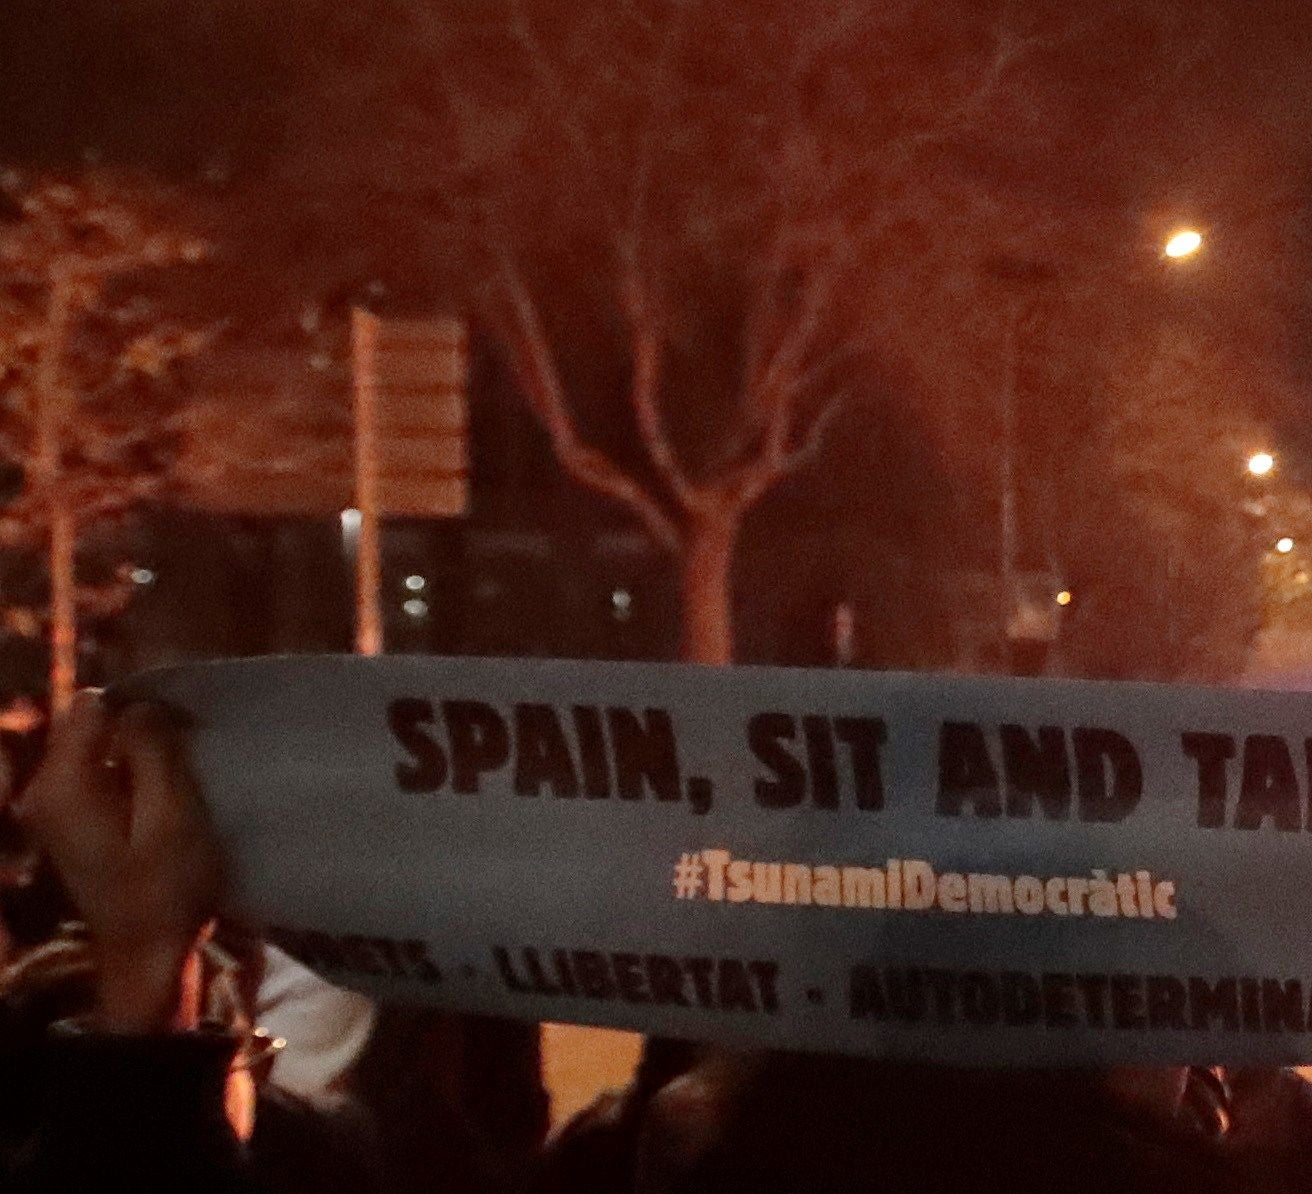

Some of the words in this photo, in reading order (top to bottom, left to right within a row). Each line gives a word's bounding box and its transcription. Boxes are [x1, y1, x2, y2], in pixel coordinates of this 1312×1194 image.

[388, 698, 712, 815] SPAIN,
[747, 713, 889, 813] SIT
[936, 721, 1143, 823] AND
[672, 848, 1178, 920] #TsunamiDemocràtic
[491, 945, 780, 1014] LLIBERTAT
